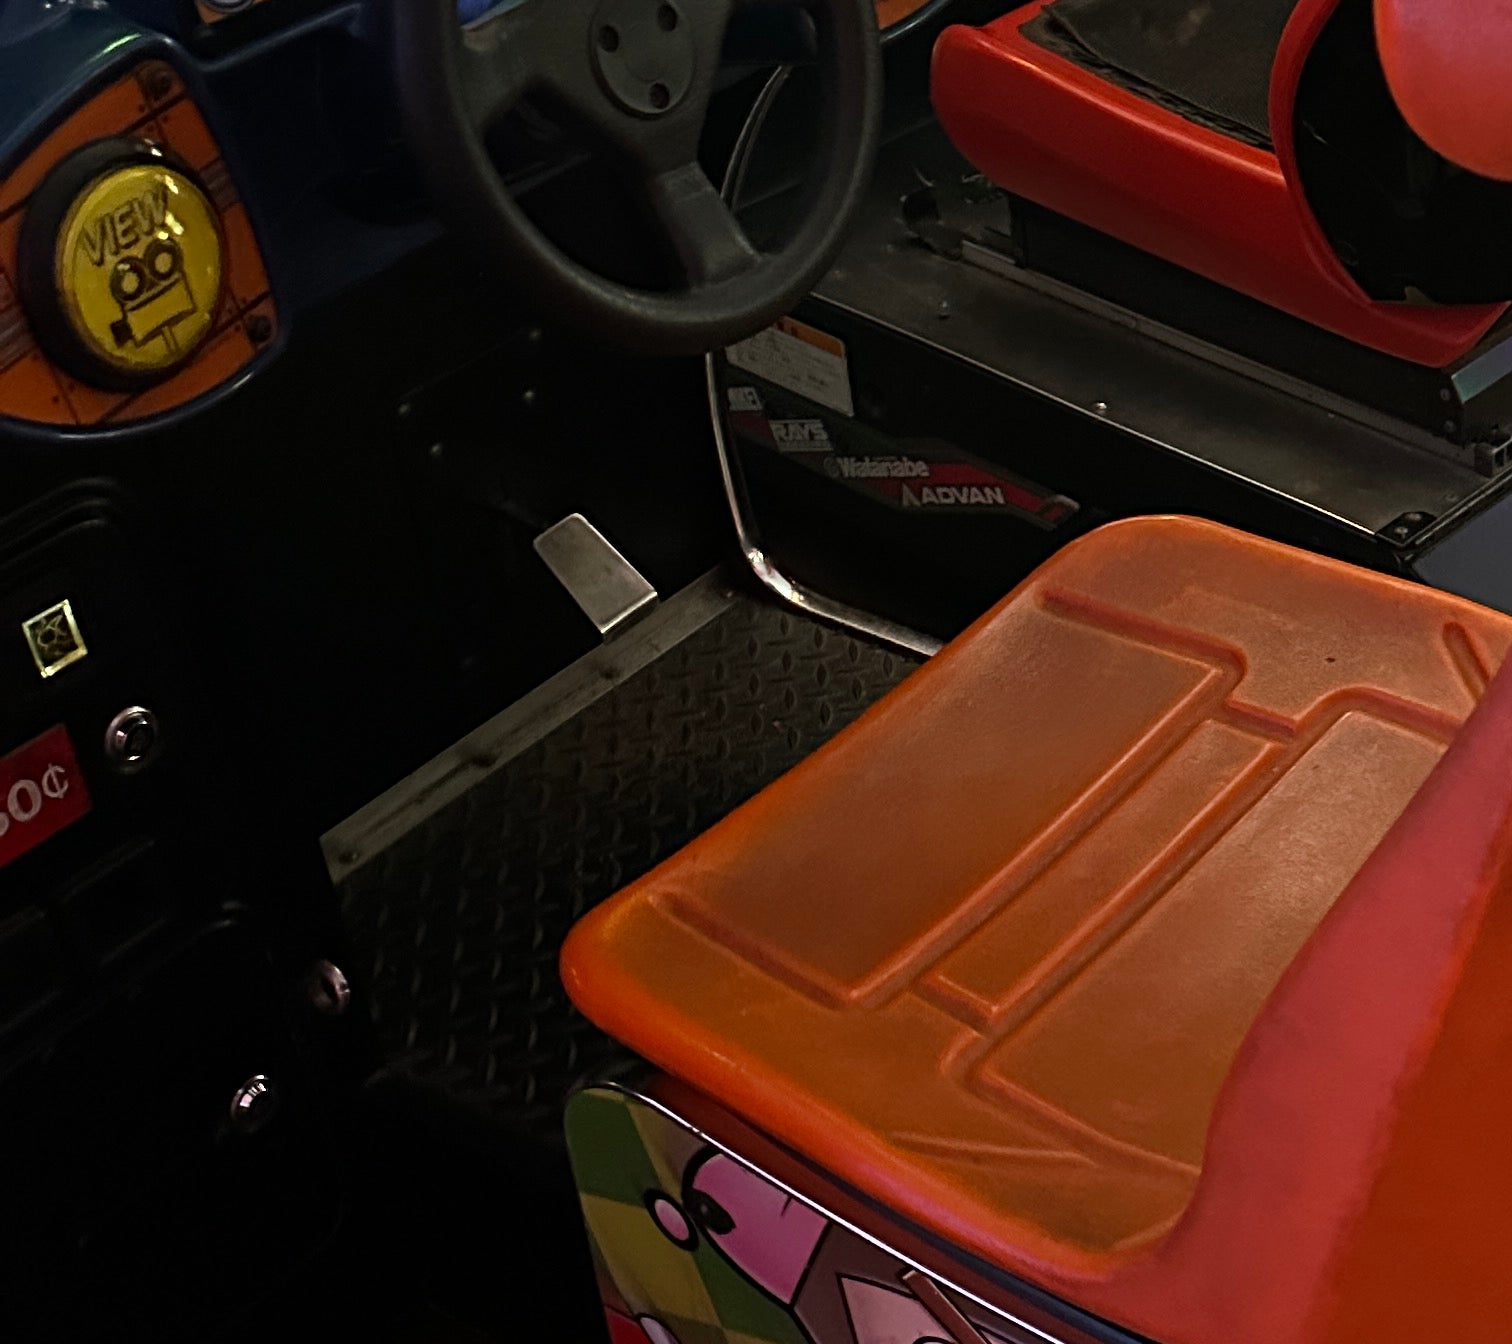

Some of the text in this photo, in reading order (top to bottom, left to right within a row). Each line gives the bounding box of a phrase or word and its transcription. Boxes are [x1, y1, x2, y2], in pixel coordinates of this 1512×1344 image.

[82, 183, 170, 267] VIEW
[771, 422, 829, 442] RAYS
[836, 457, 930, 478] Watanabe
[922, 486, 1005, 505] ADVAN
[0, 762, 69, 837] 0¢
